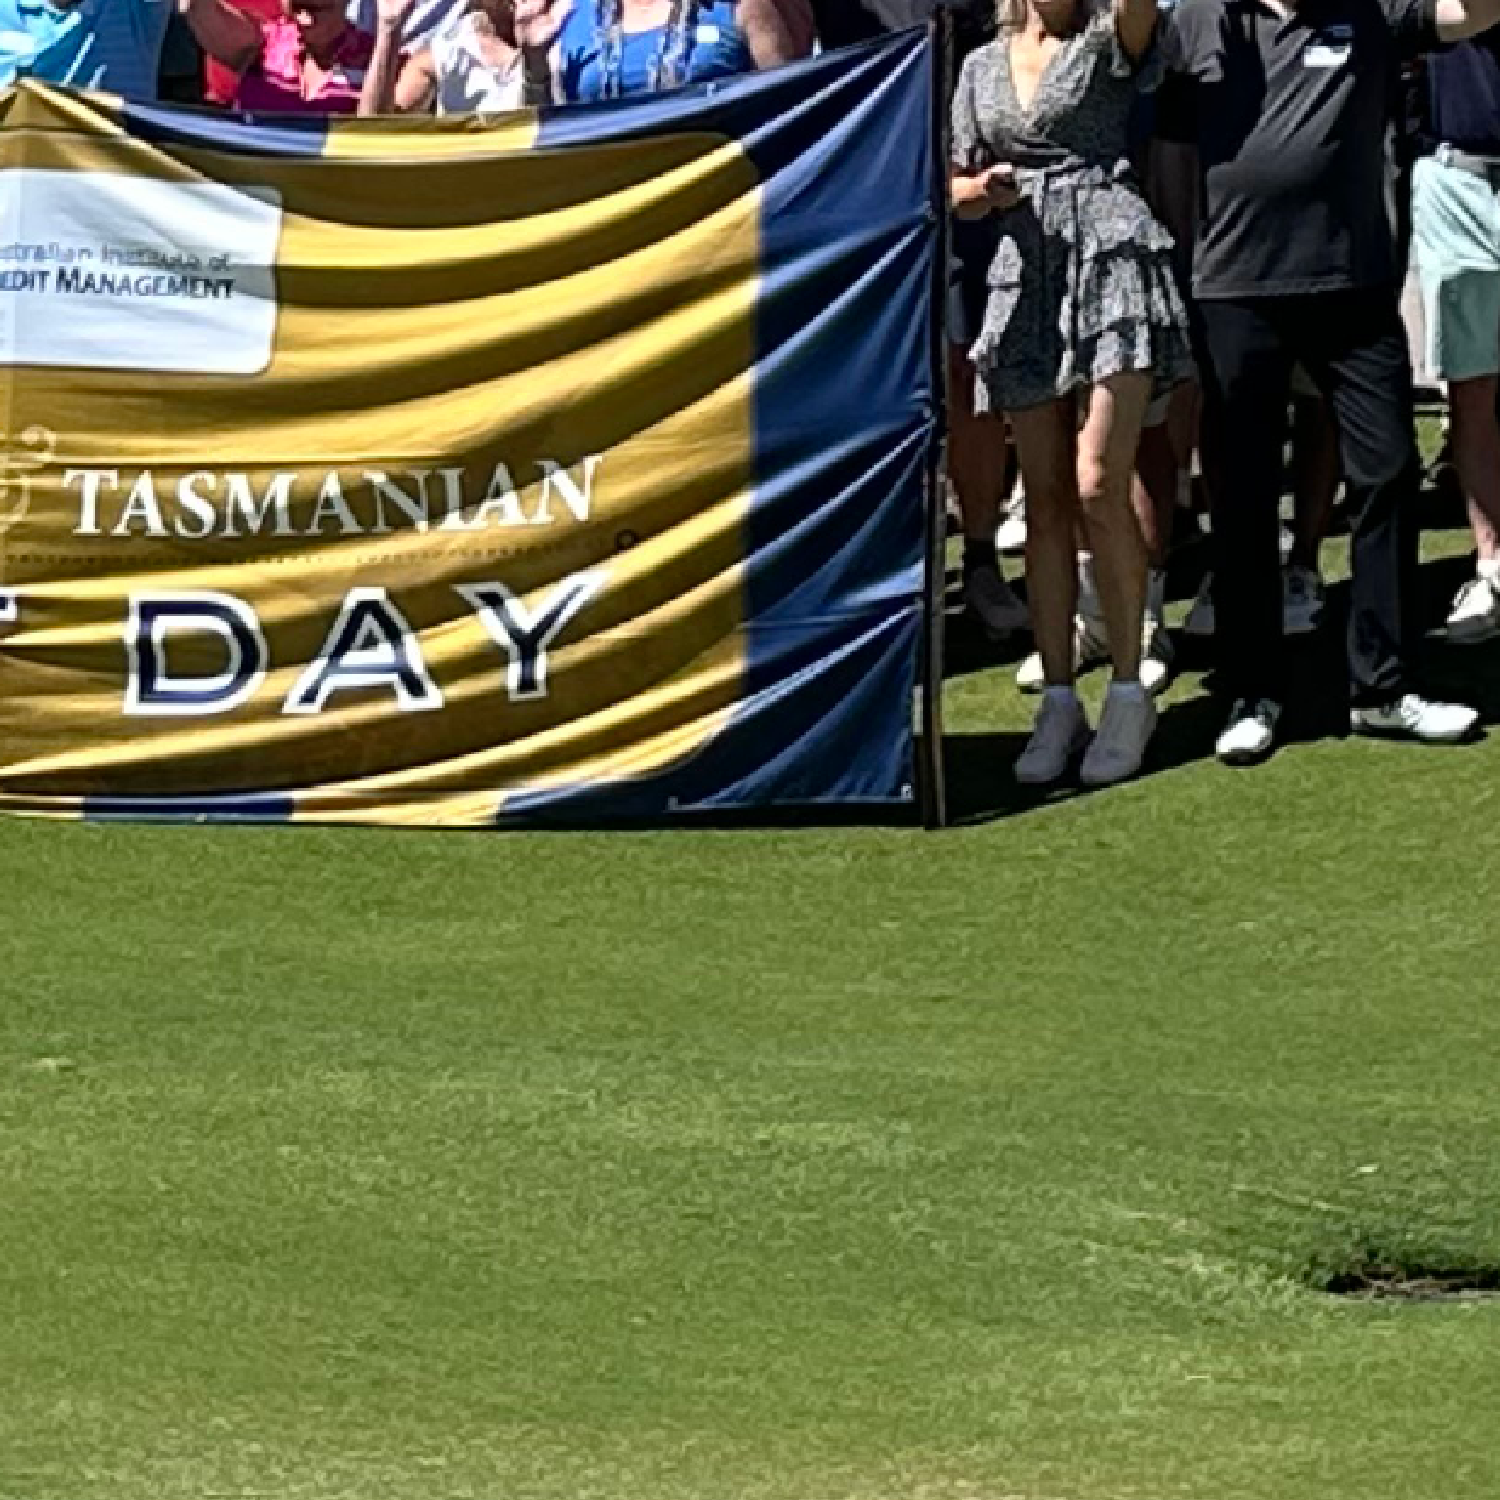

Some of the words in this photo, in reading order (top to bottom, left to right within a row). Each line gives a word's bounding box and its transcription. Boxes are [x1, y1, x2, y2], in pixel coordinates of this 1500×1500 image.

[55, 266, 237, 299] MANAGEMENT
[63, 455, 603, 538] TASMANIAN
[122, 570, 613, 715] DAY
